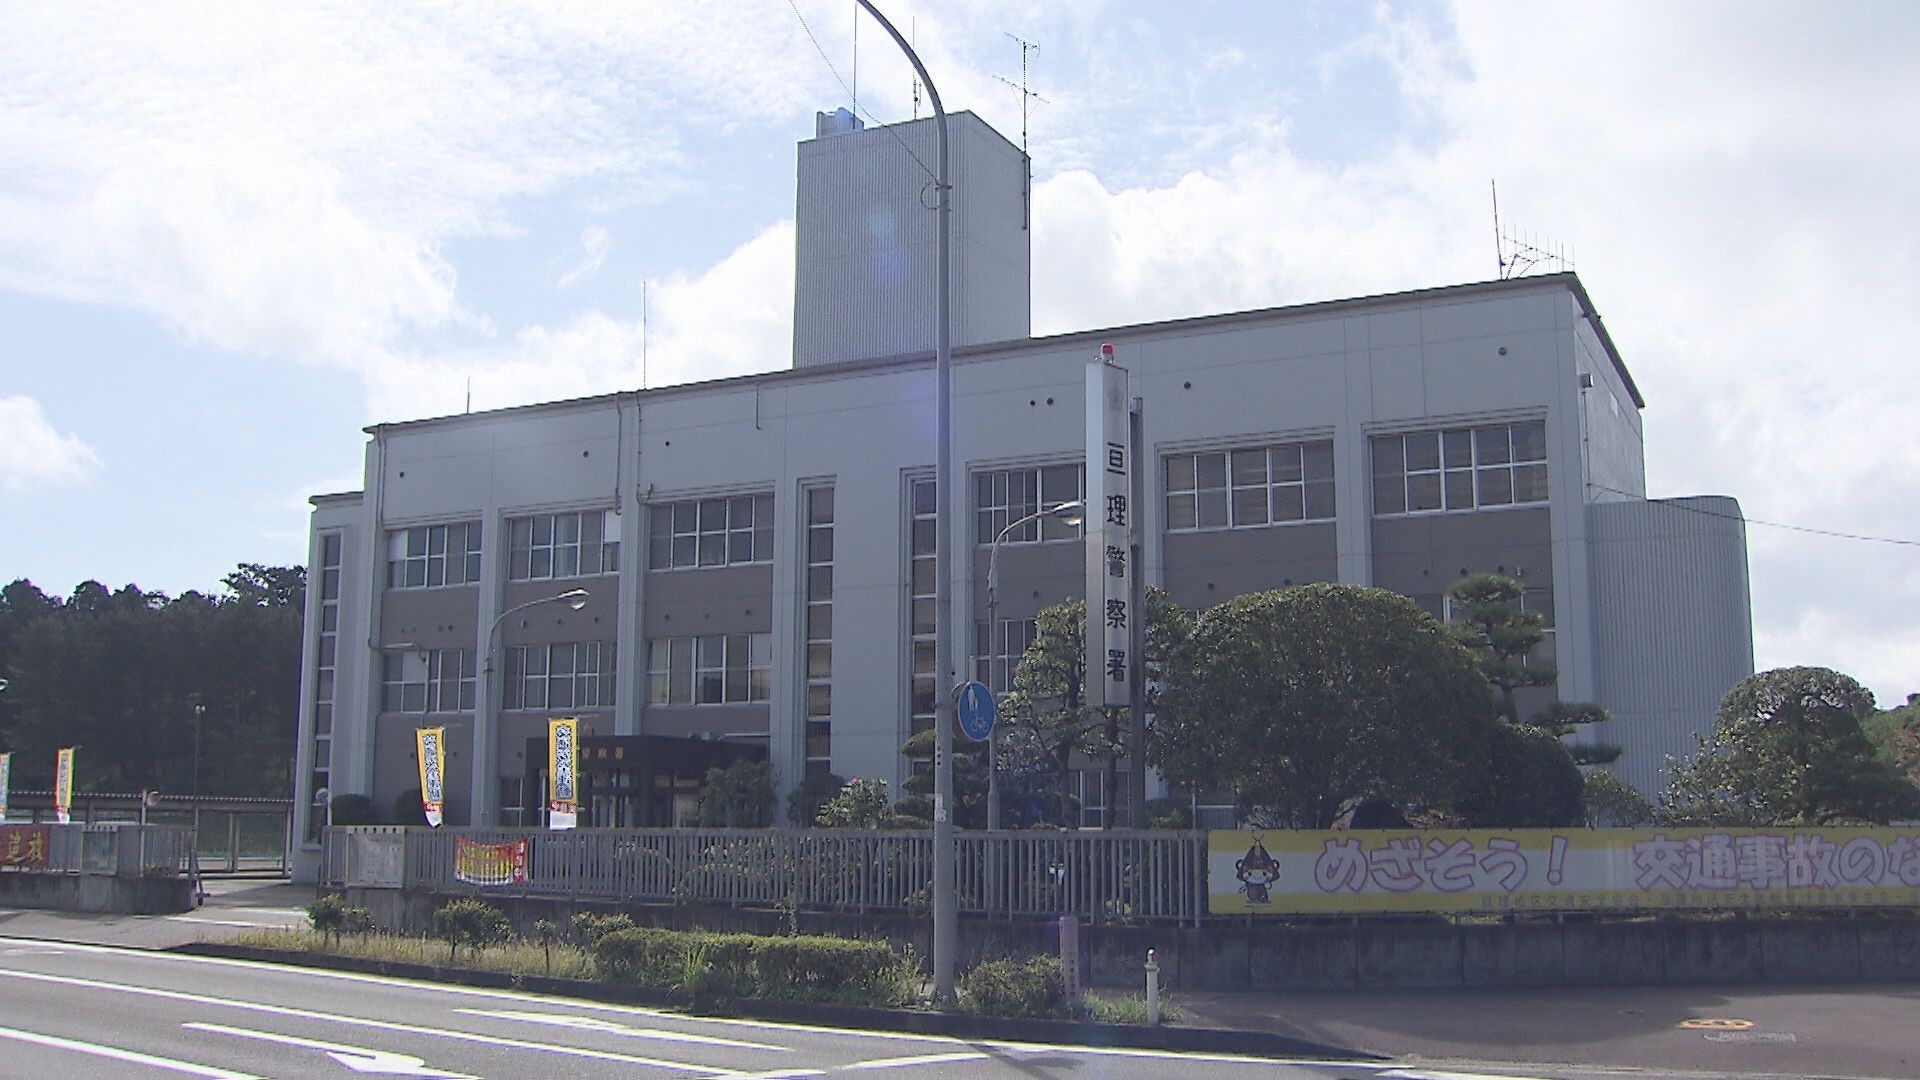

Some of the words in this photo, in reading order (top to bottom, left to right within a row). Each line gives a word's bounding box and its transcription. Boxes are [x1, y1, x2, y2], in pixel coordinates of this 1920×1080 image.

[1106, 441, 1127, 682] 亘理警察署
